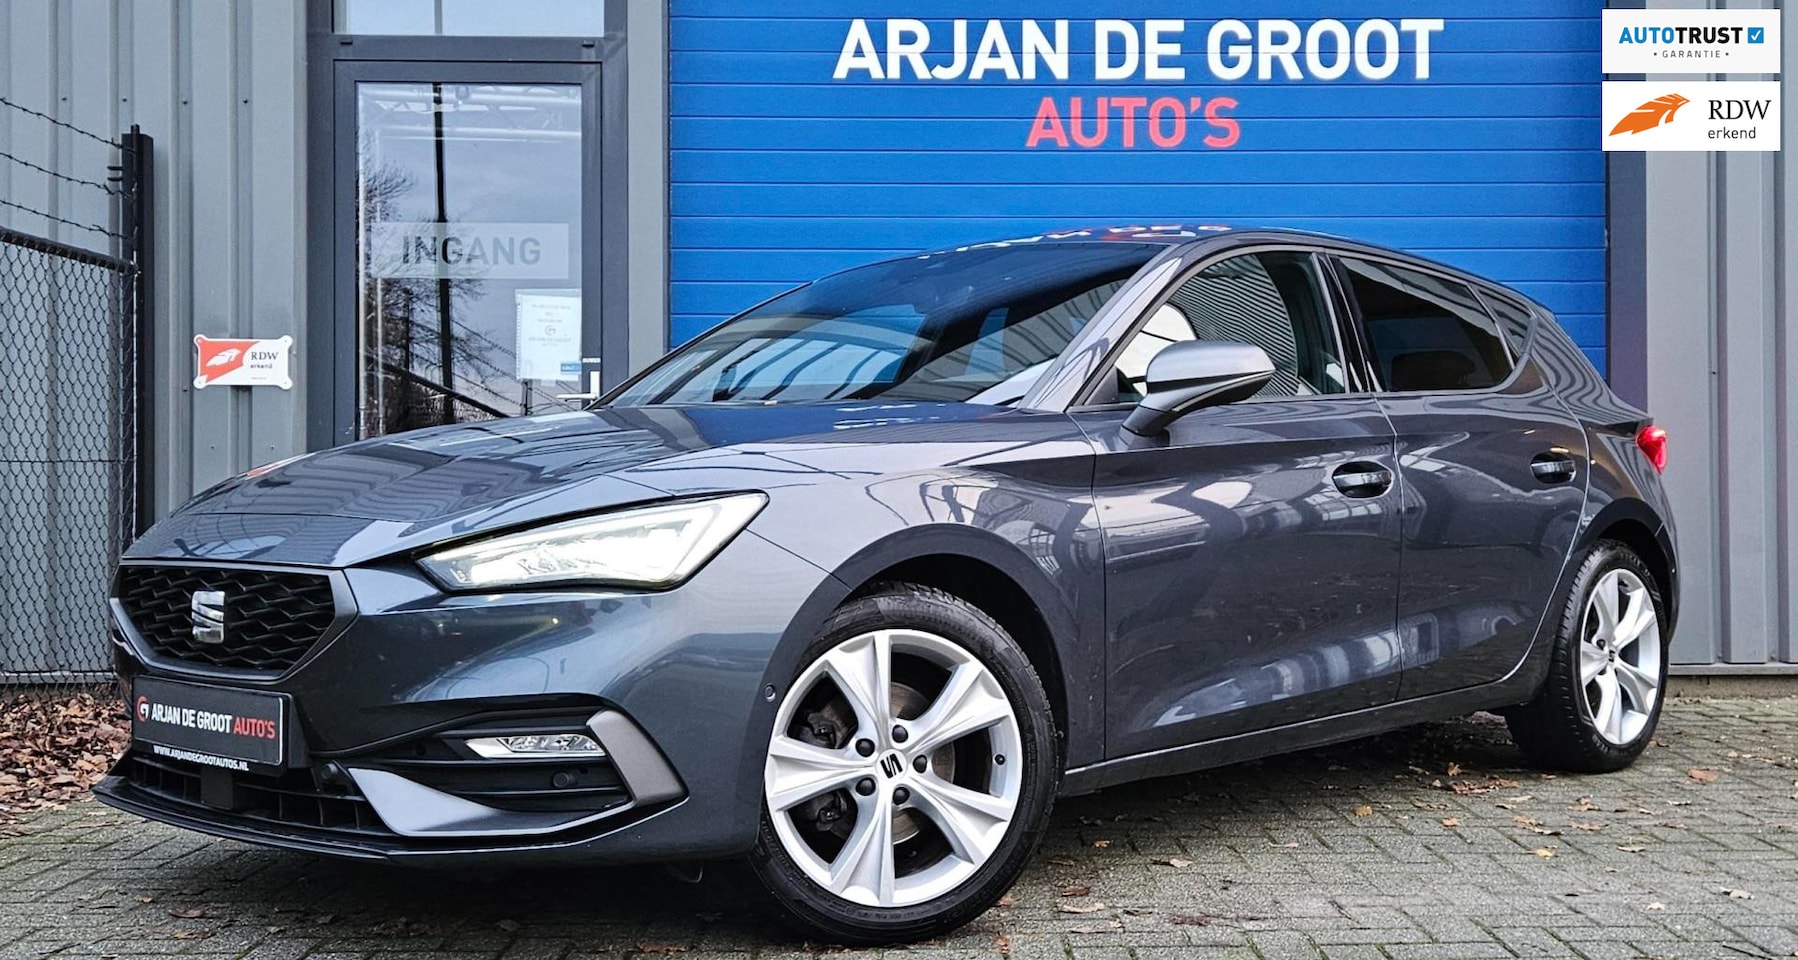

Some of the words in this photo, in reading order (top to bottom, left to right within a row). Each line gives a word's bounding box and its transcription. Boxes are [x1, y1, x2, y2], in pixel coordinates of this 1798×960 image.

[831, 18, 1069, 80] ARJAN
[1095, 18, 1185, 80] DE
[1206, 18, 1445, 80] GROOT
[1025, 96, 1241, 149] AUTO'S
[402, 235, 541, 265] INGANG
[251, 351, 279, 361] RDW
[151, 703, 181, 725] ARJAN
[182, 708, 196, 728] DE
[197, 710, 233, 733] GROOT
[233, 716, 276, 739] AUTO'S
[153, 744, 250, 771] WWW.ARJANDEGROOTAUTOS.NL
